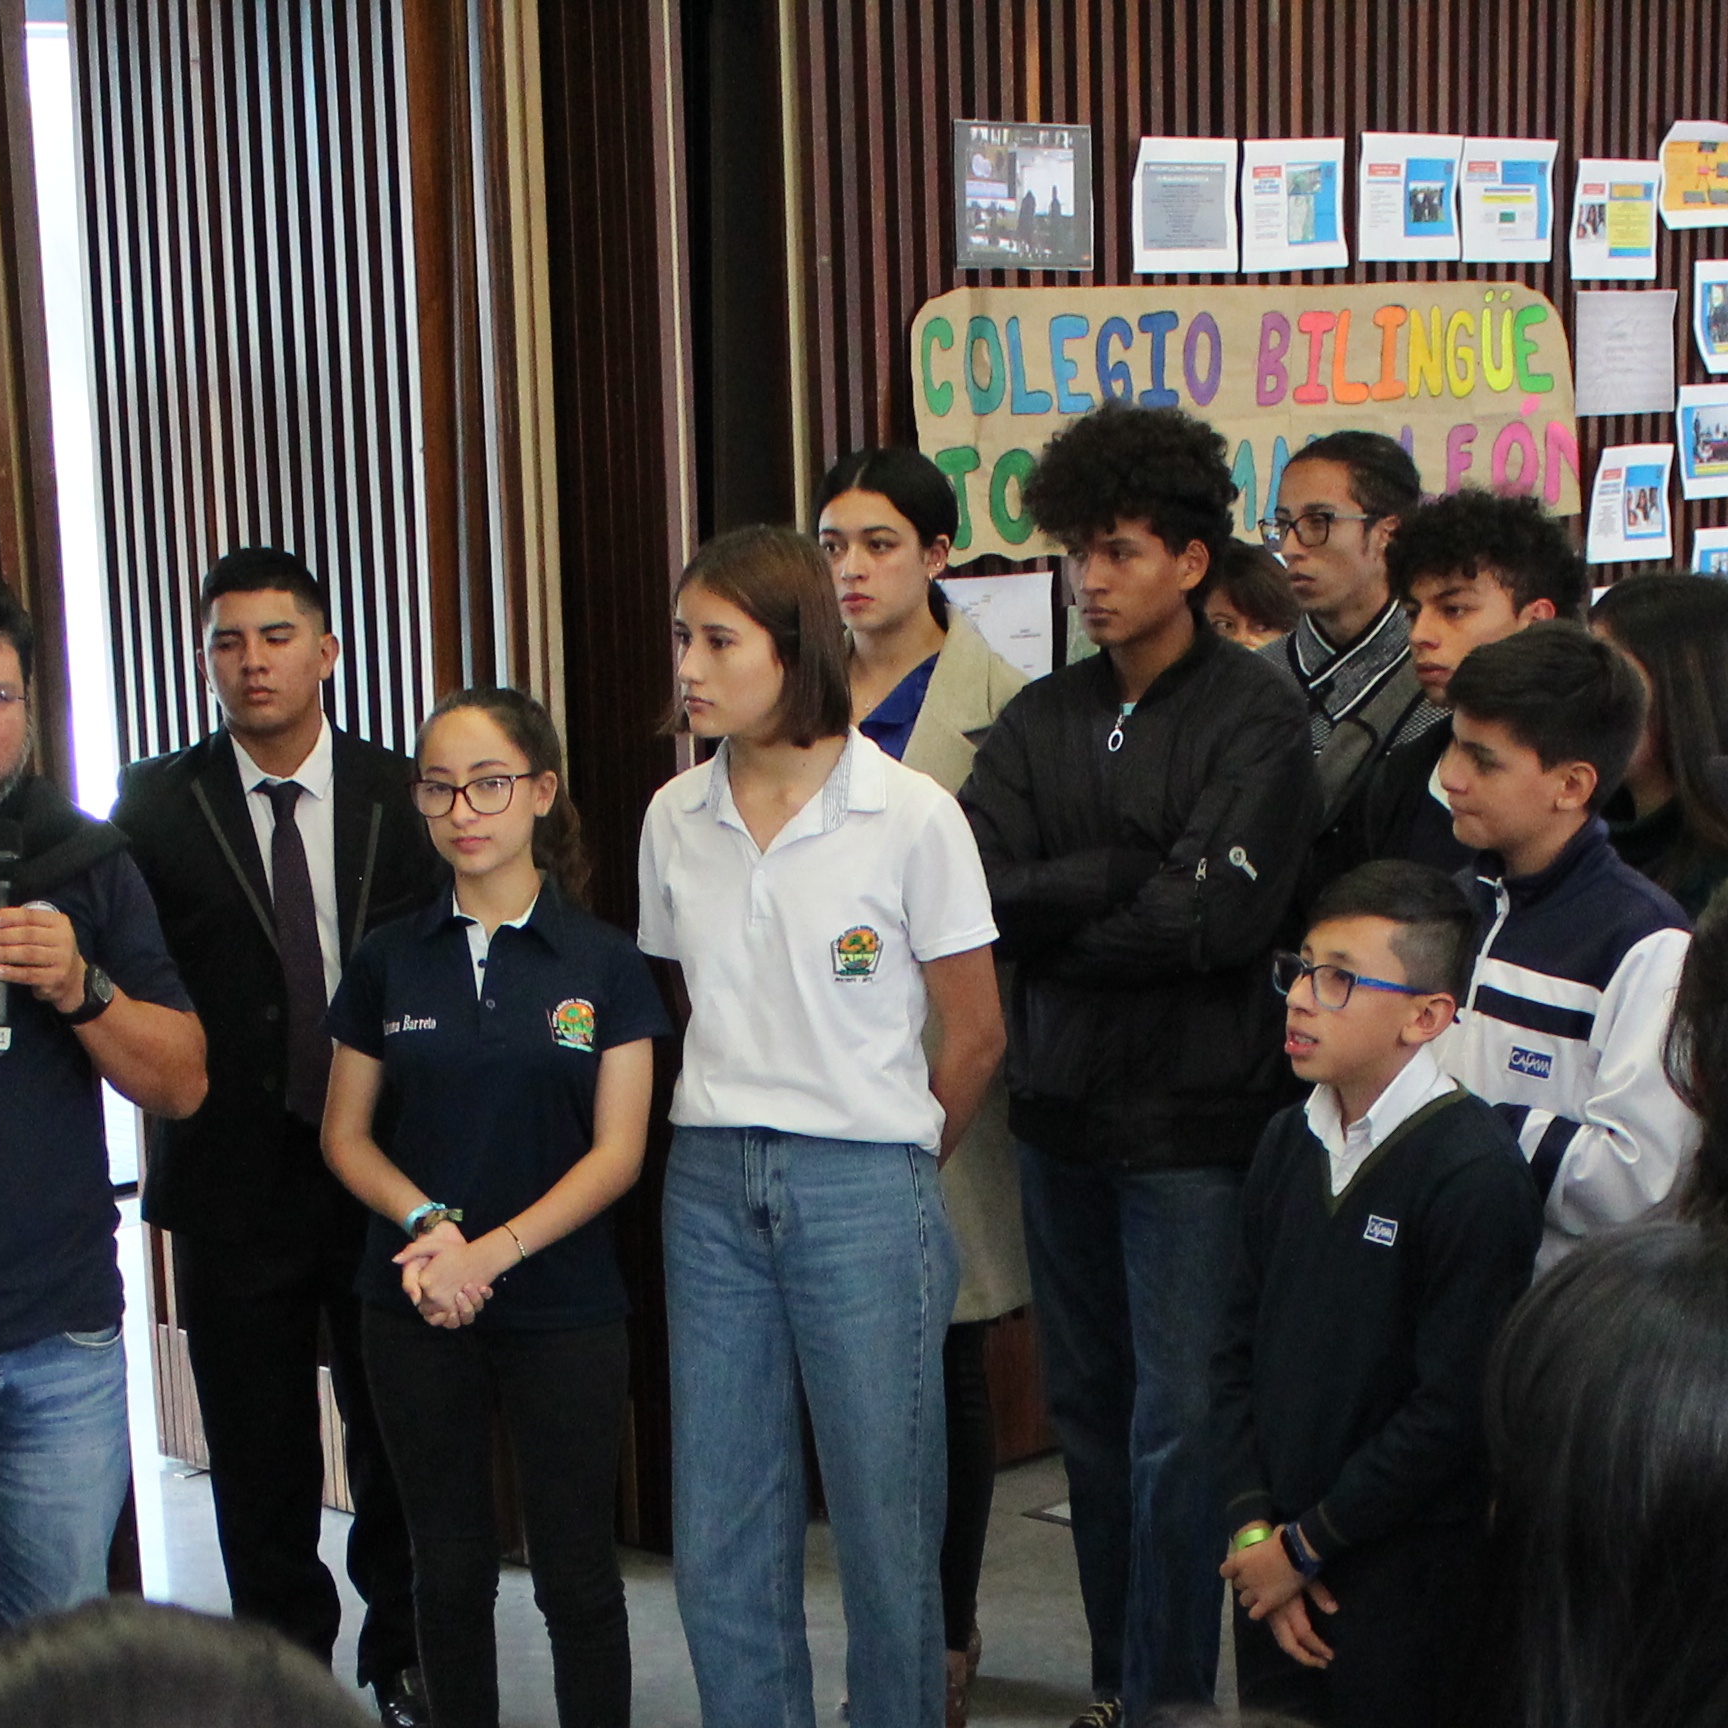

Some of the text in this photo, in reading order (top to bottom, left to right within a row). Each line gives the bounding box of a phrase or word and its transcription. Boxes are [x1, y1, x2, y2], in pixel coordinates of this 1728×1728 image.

[920, 308, 1221, 417] COLEGIO
[1255, 289, 1555, 407] BILINGÜE
[403, 1014, 437, 1031] Barreto
